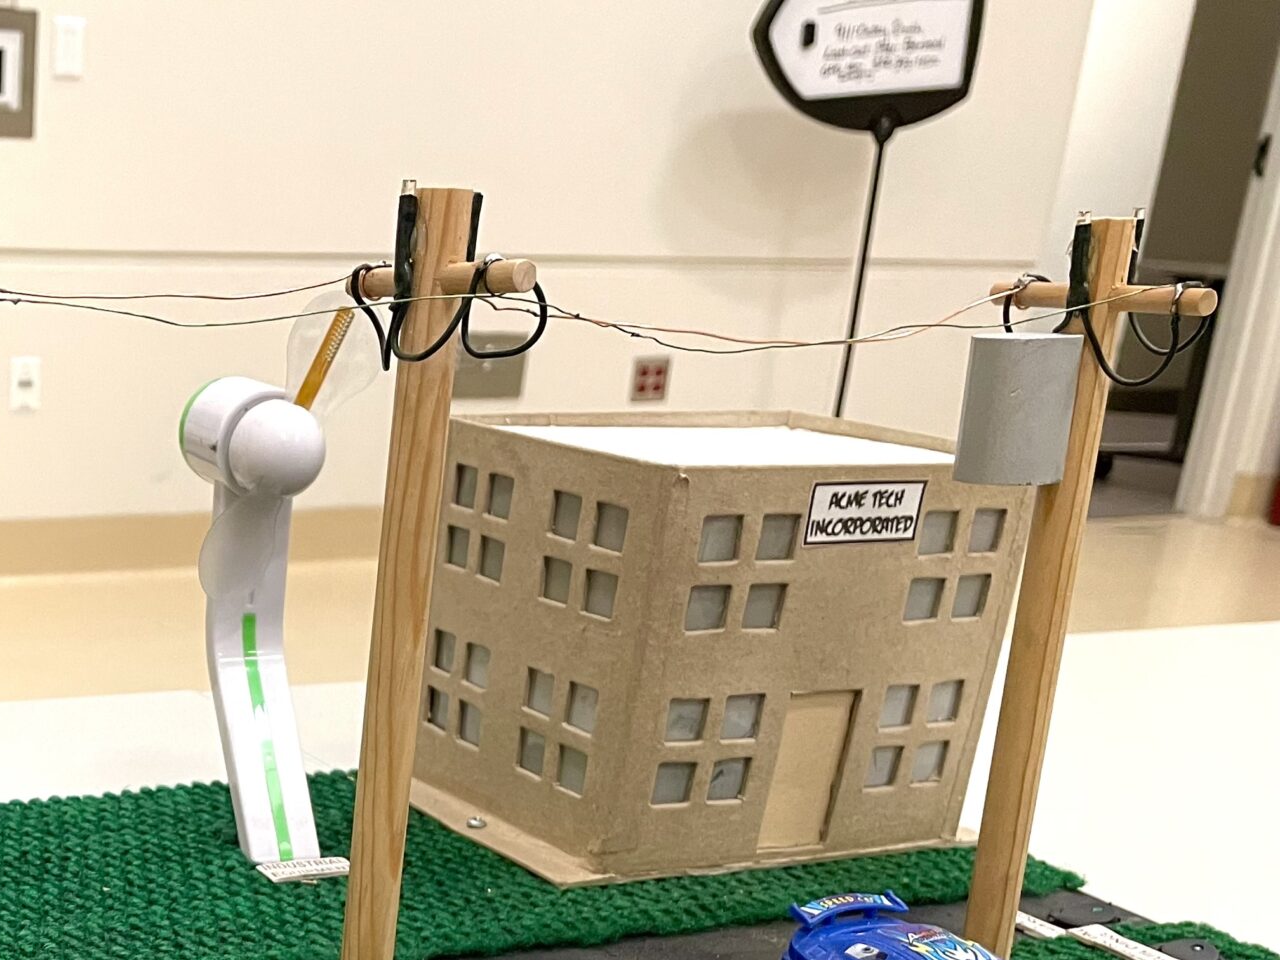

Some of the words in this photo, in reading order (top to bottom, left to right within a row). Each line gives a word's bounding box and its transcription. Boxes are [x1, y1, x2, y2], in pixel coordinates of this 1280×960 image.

[828, 489, 869, 510] ACME
[872, 488, 906, 508] TECH
[810, 515, 914, 537] INCORPORATED
[261, 857, 346, 871] INDUSTRIAL
